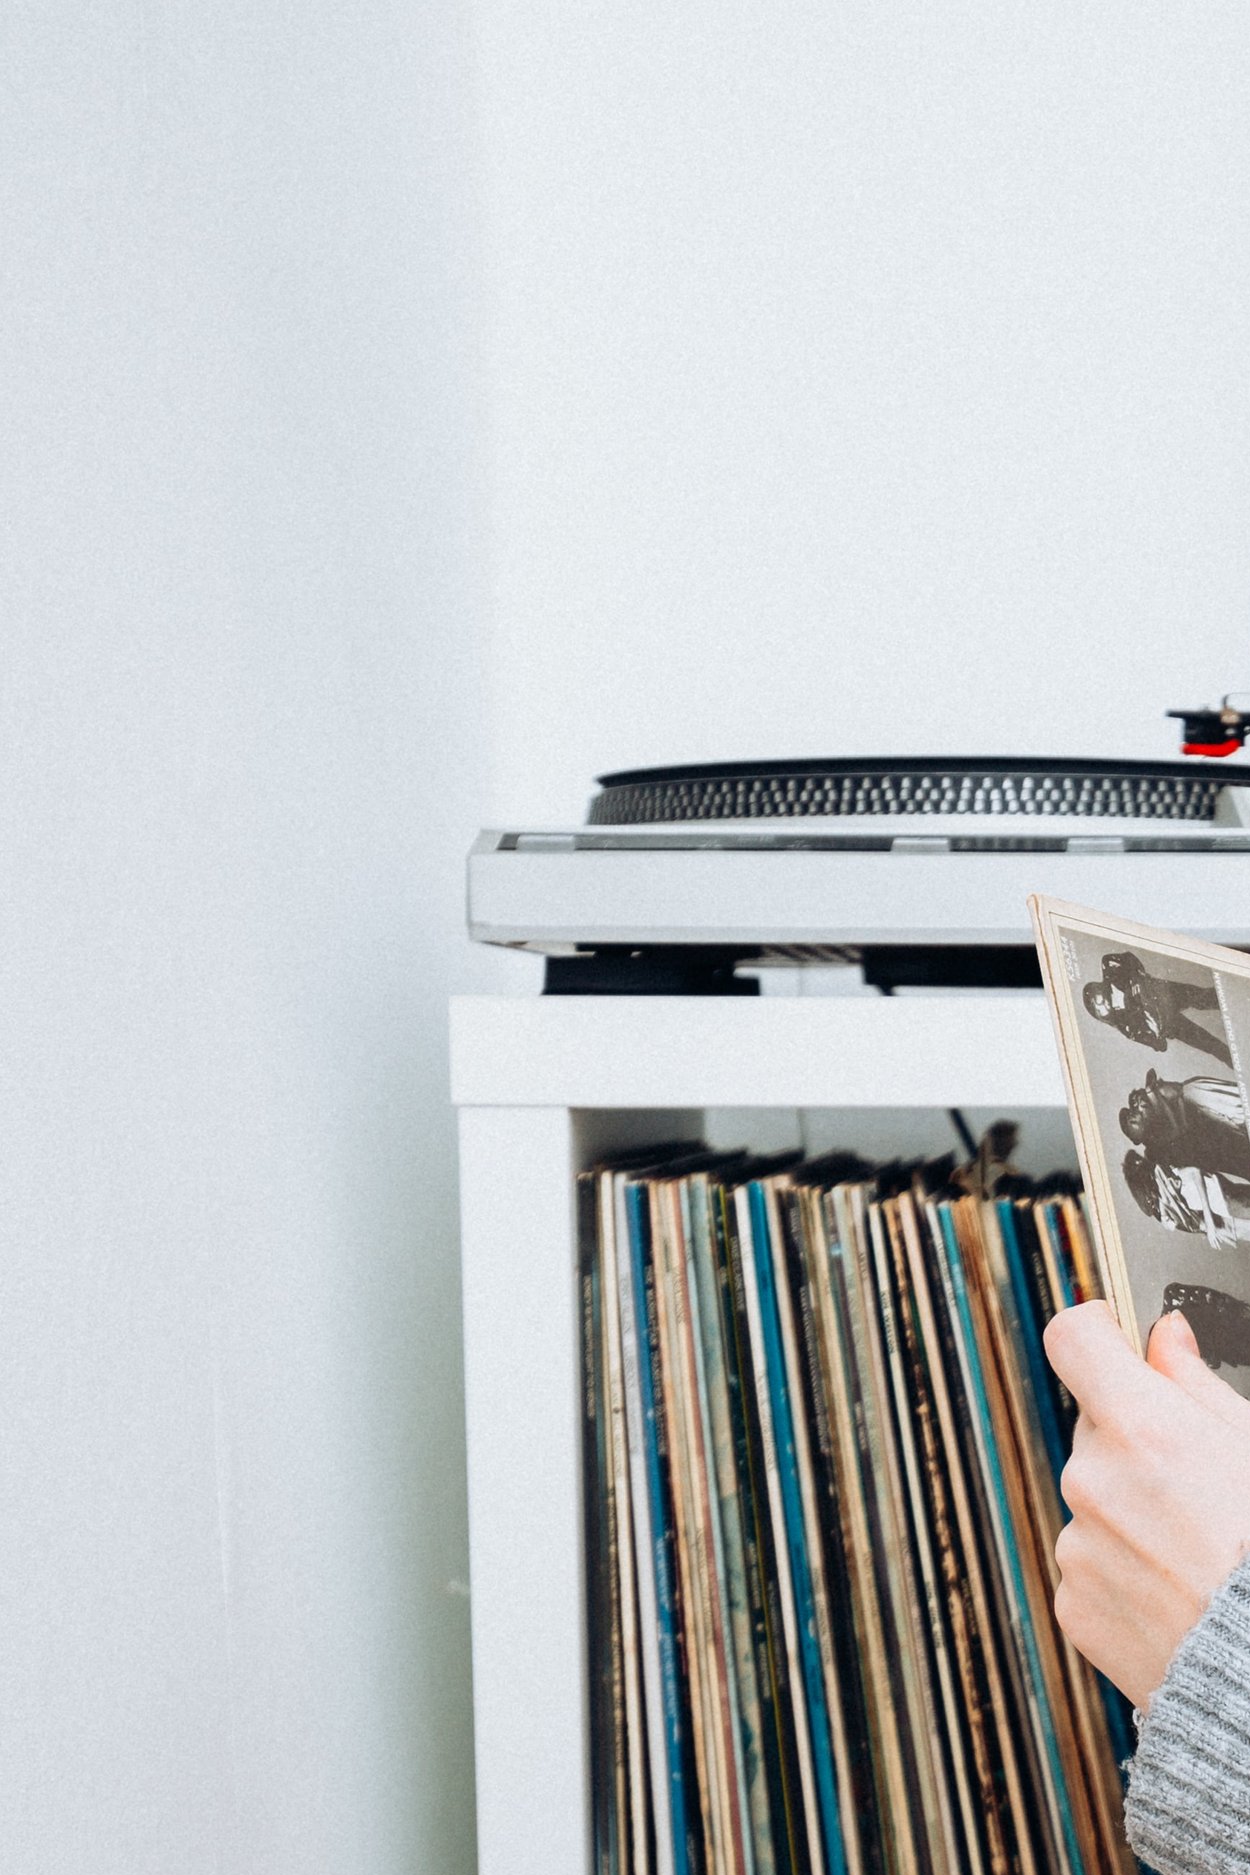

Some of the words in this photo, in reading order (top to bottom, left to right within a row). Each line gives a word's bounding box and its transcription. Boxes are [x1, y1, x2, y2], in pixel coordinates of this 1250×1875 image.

[1212, 970, 1228, 1012] WOMAN
[1222, 1014, 1235, 1041] DUST
[1230, 1042, 1242, 1073] GOLD
[1238, 1081, 1250, 1116] DADDY
